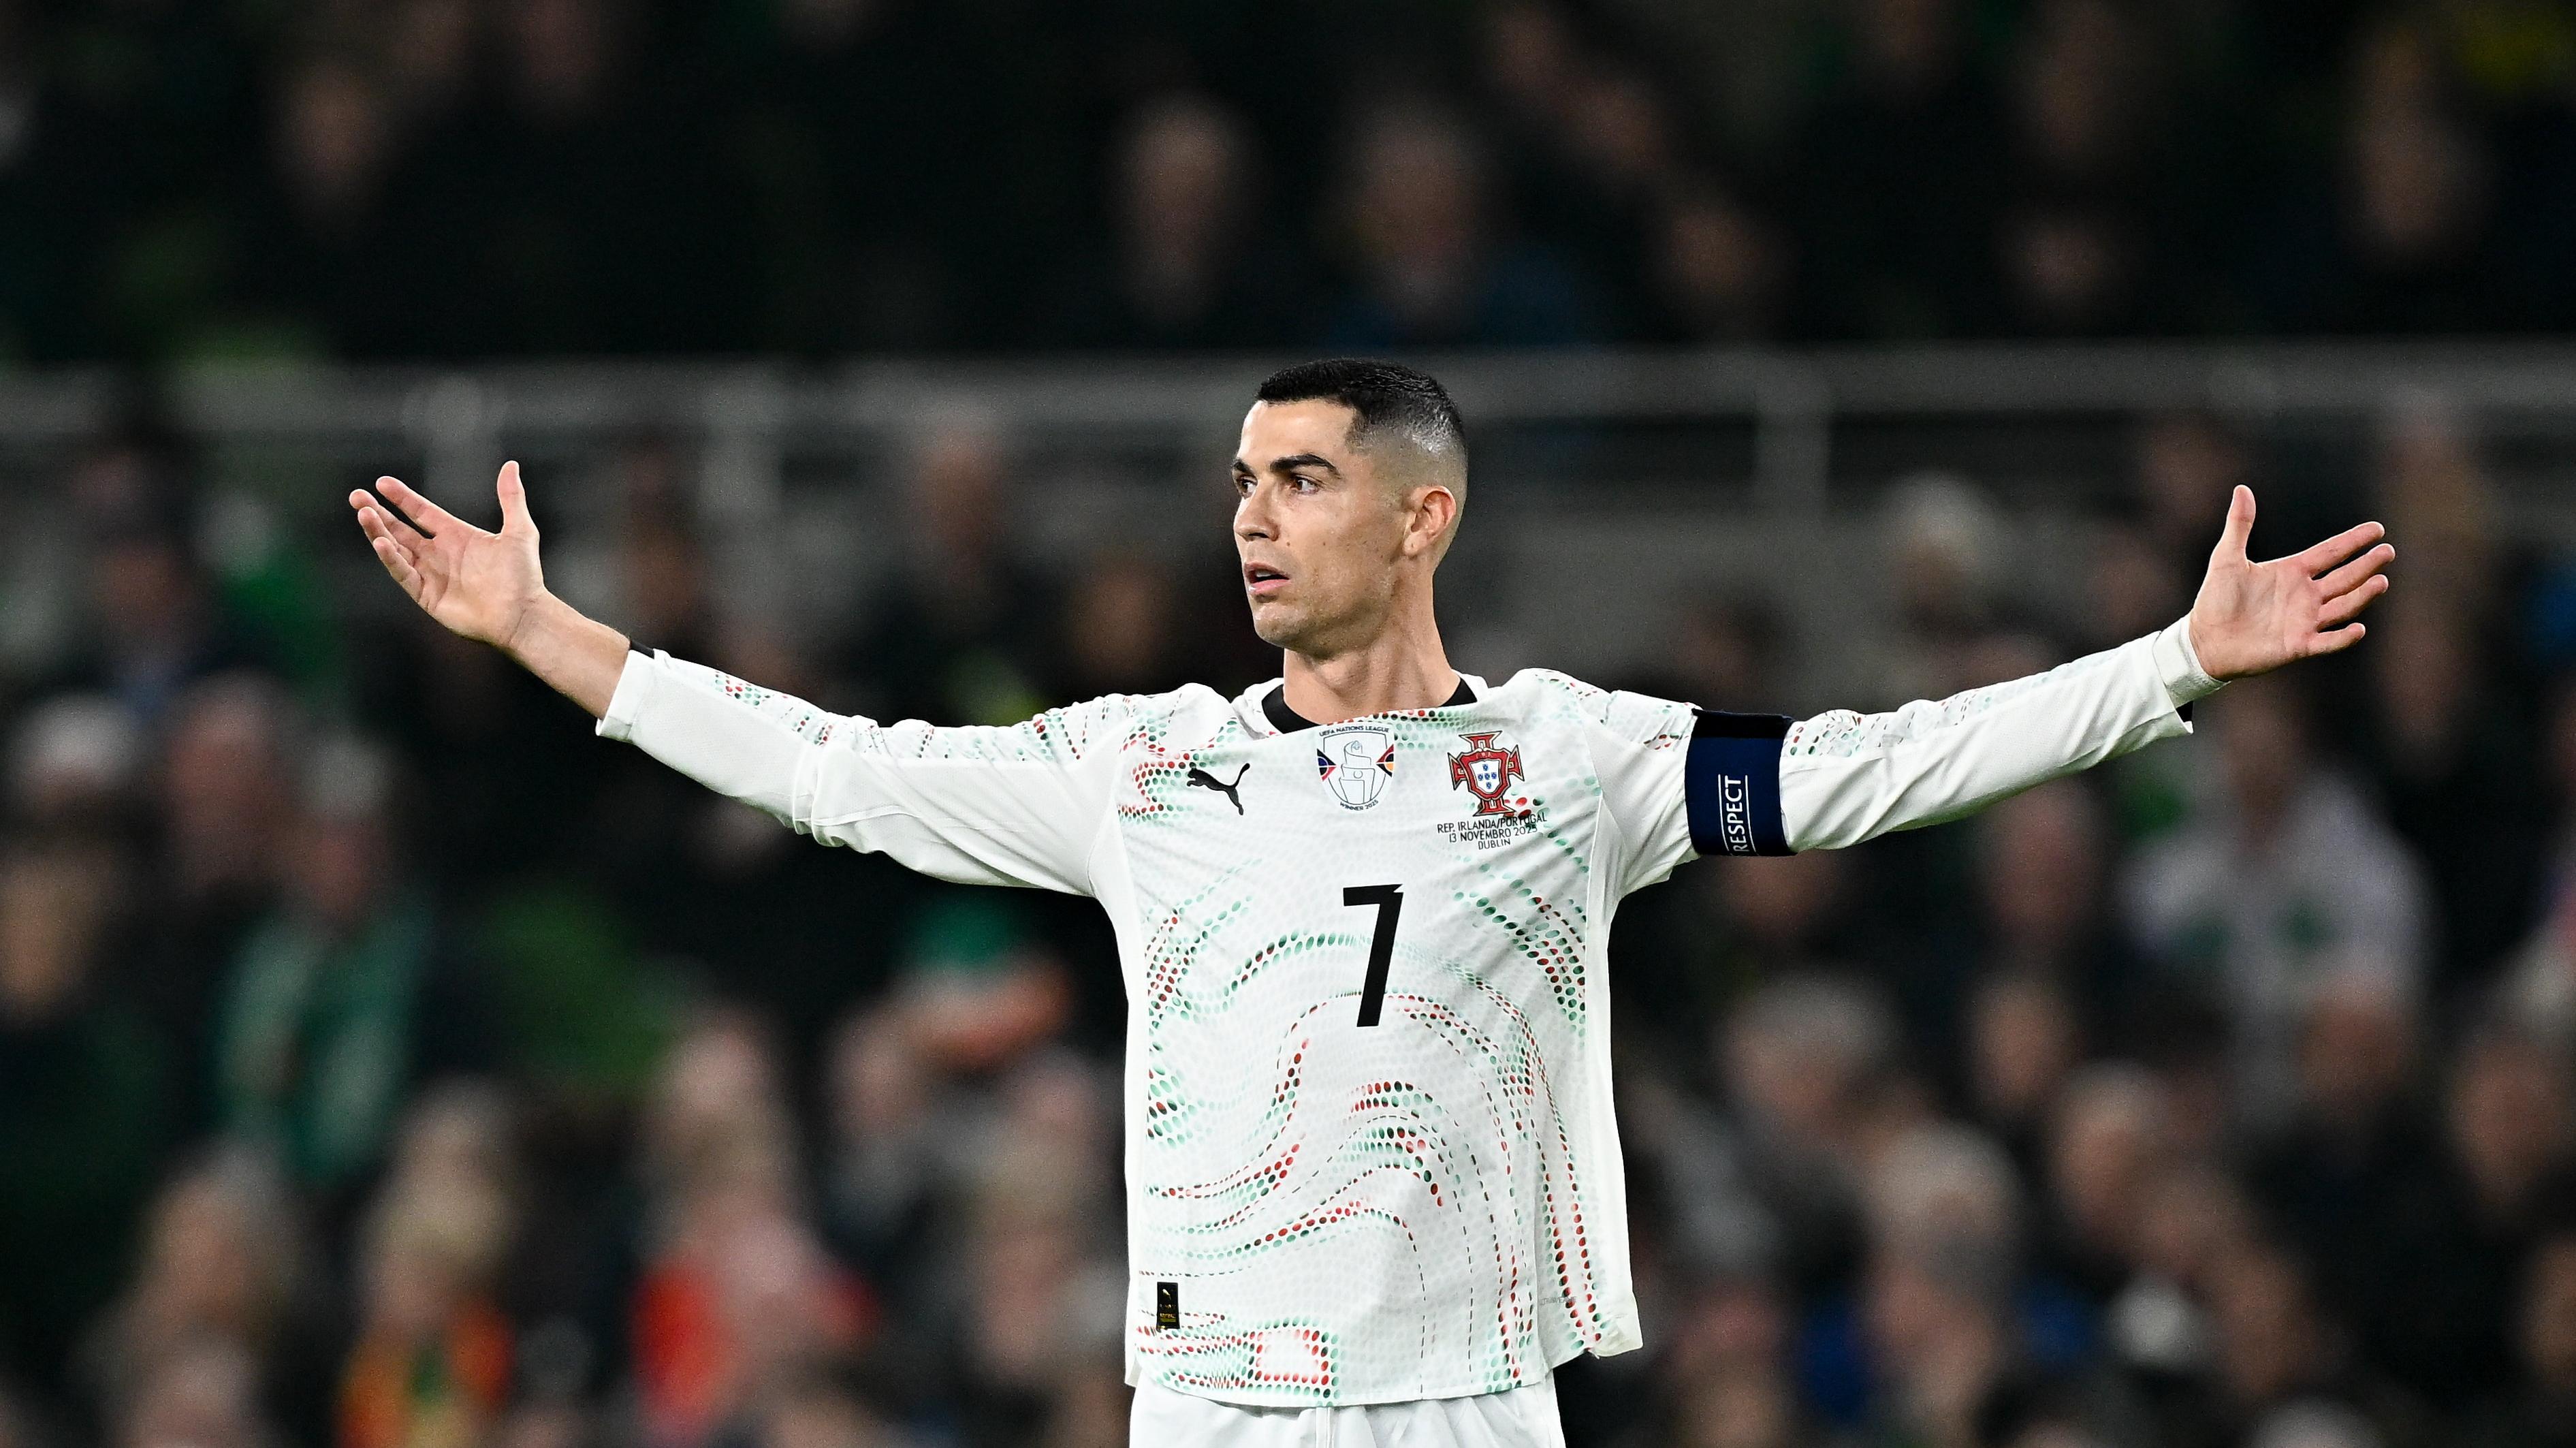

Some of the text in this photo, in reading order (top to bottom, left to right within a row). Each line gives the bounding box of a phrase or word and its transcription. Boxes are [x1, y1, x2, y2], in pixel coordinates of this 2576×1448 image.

[1724, 775, 1750, 852] RESPECT
[1437, 823, 1455, 834] REP.
[1449, 825, 1538, 843] 13 NOVEMBRO 2025
[1478, 838, 1511, 850] DUBLIN
[1343, 883, 1403, 1027] 7
